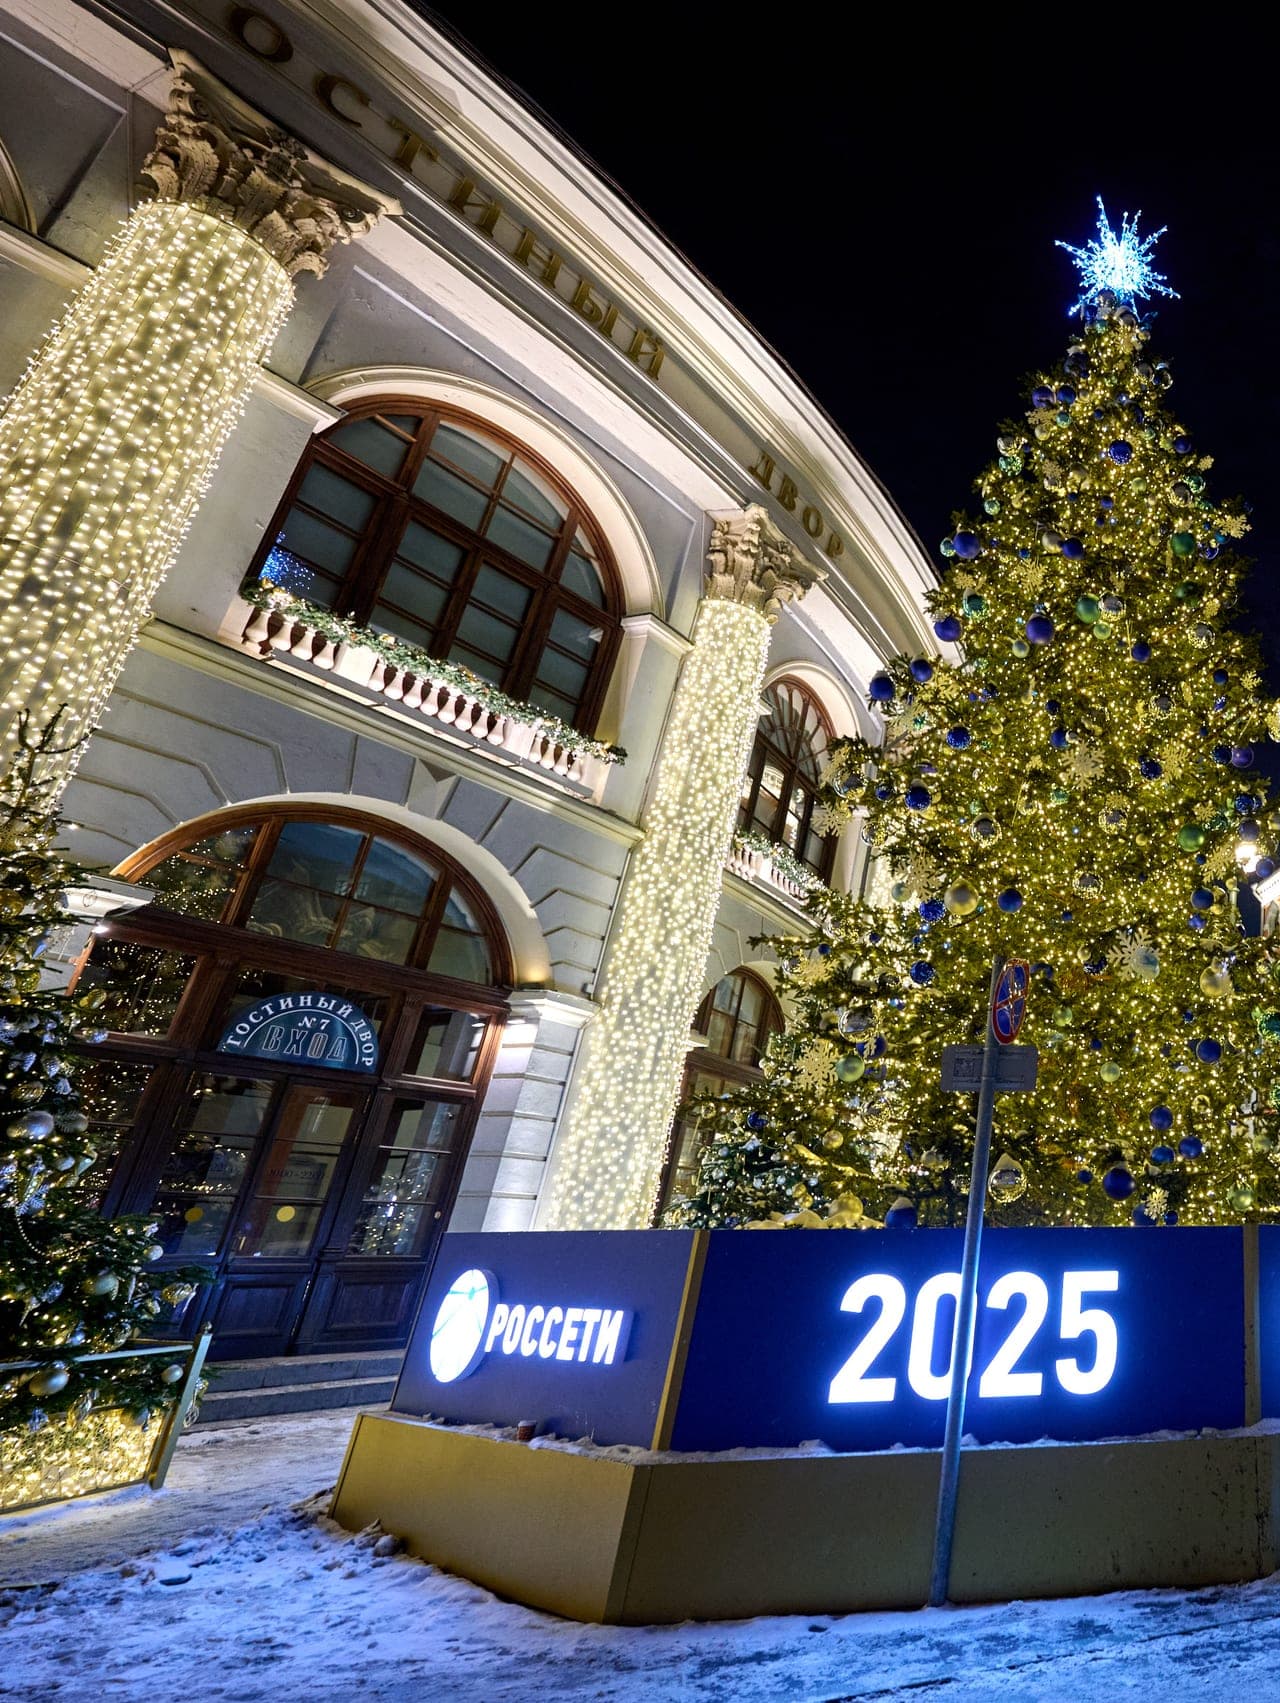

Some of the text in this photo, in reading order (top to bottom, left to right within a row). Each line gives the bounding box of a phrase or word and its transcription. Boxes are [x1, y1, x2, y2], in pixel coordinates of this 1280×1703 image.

[228, 6, 847, 559] ОСТИНЫЙ ДВОР
[226, 995, 375, 1067] ГОСТИНЫЙ ДВОР
[262, 1024, 348, 1062] ВХОД
[485, 1303, 625, 1366] РОССЕТИ
[828, 1270, 1119, 1404] 2025
